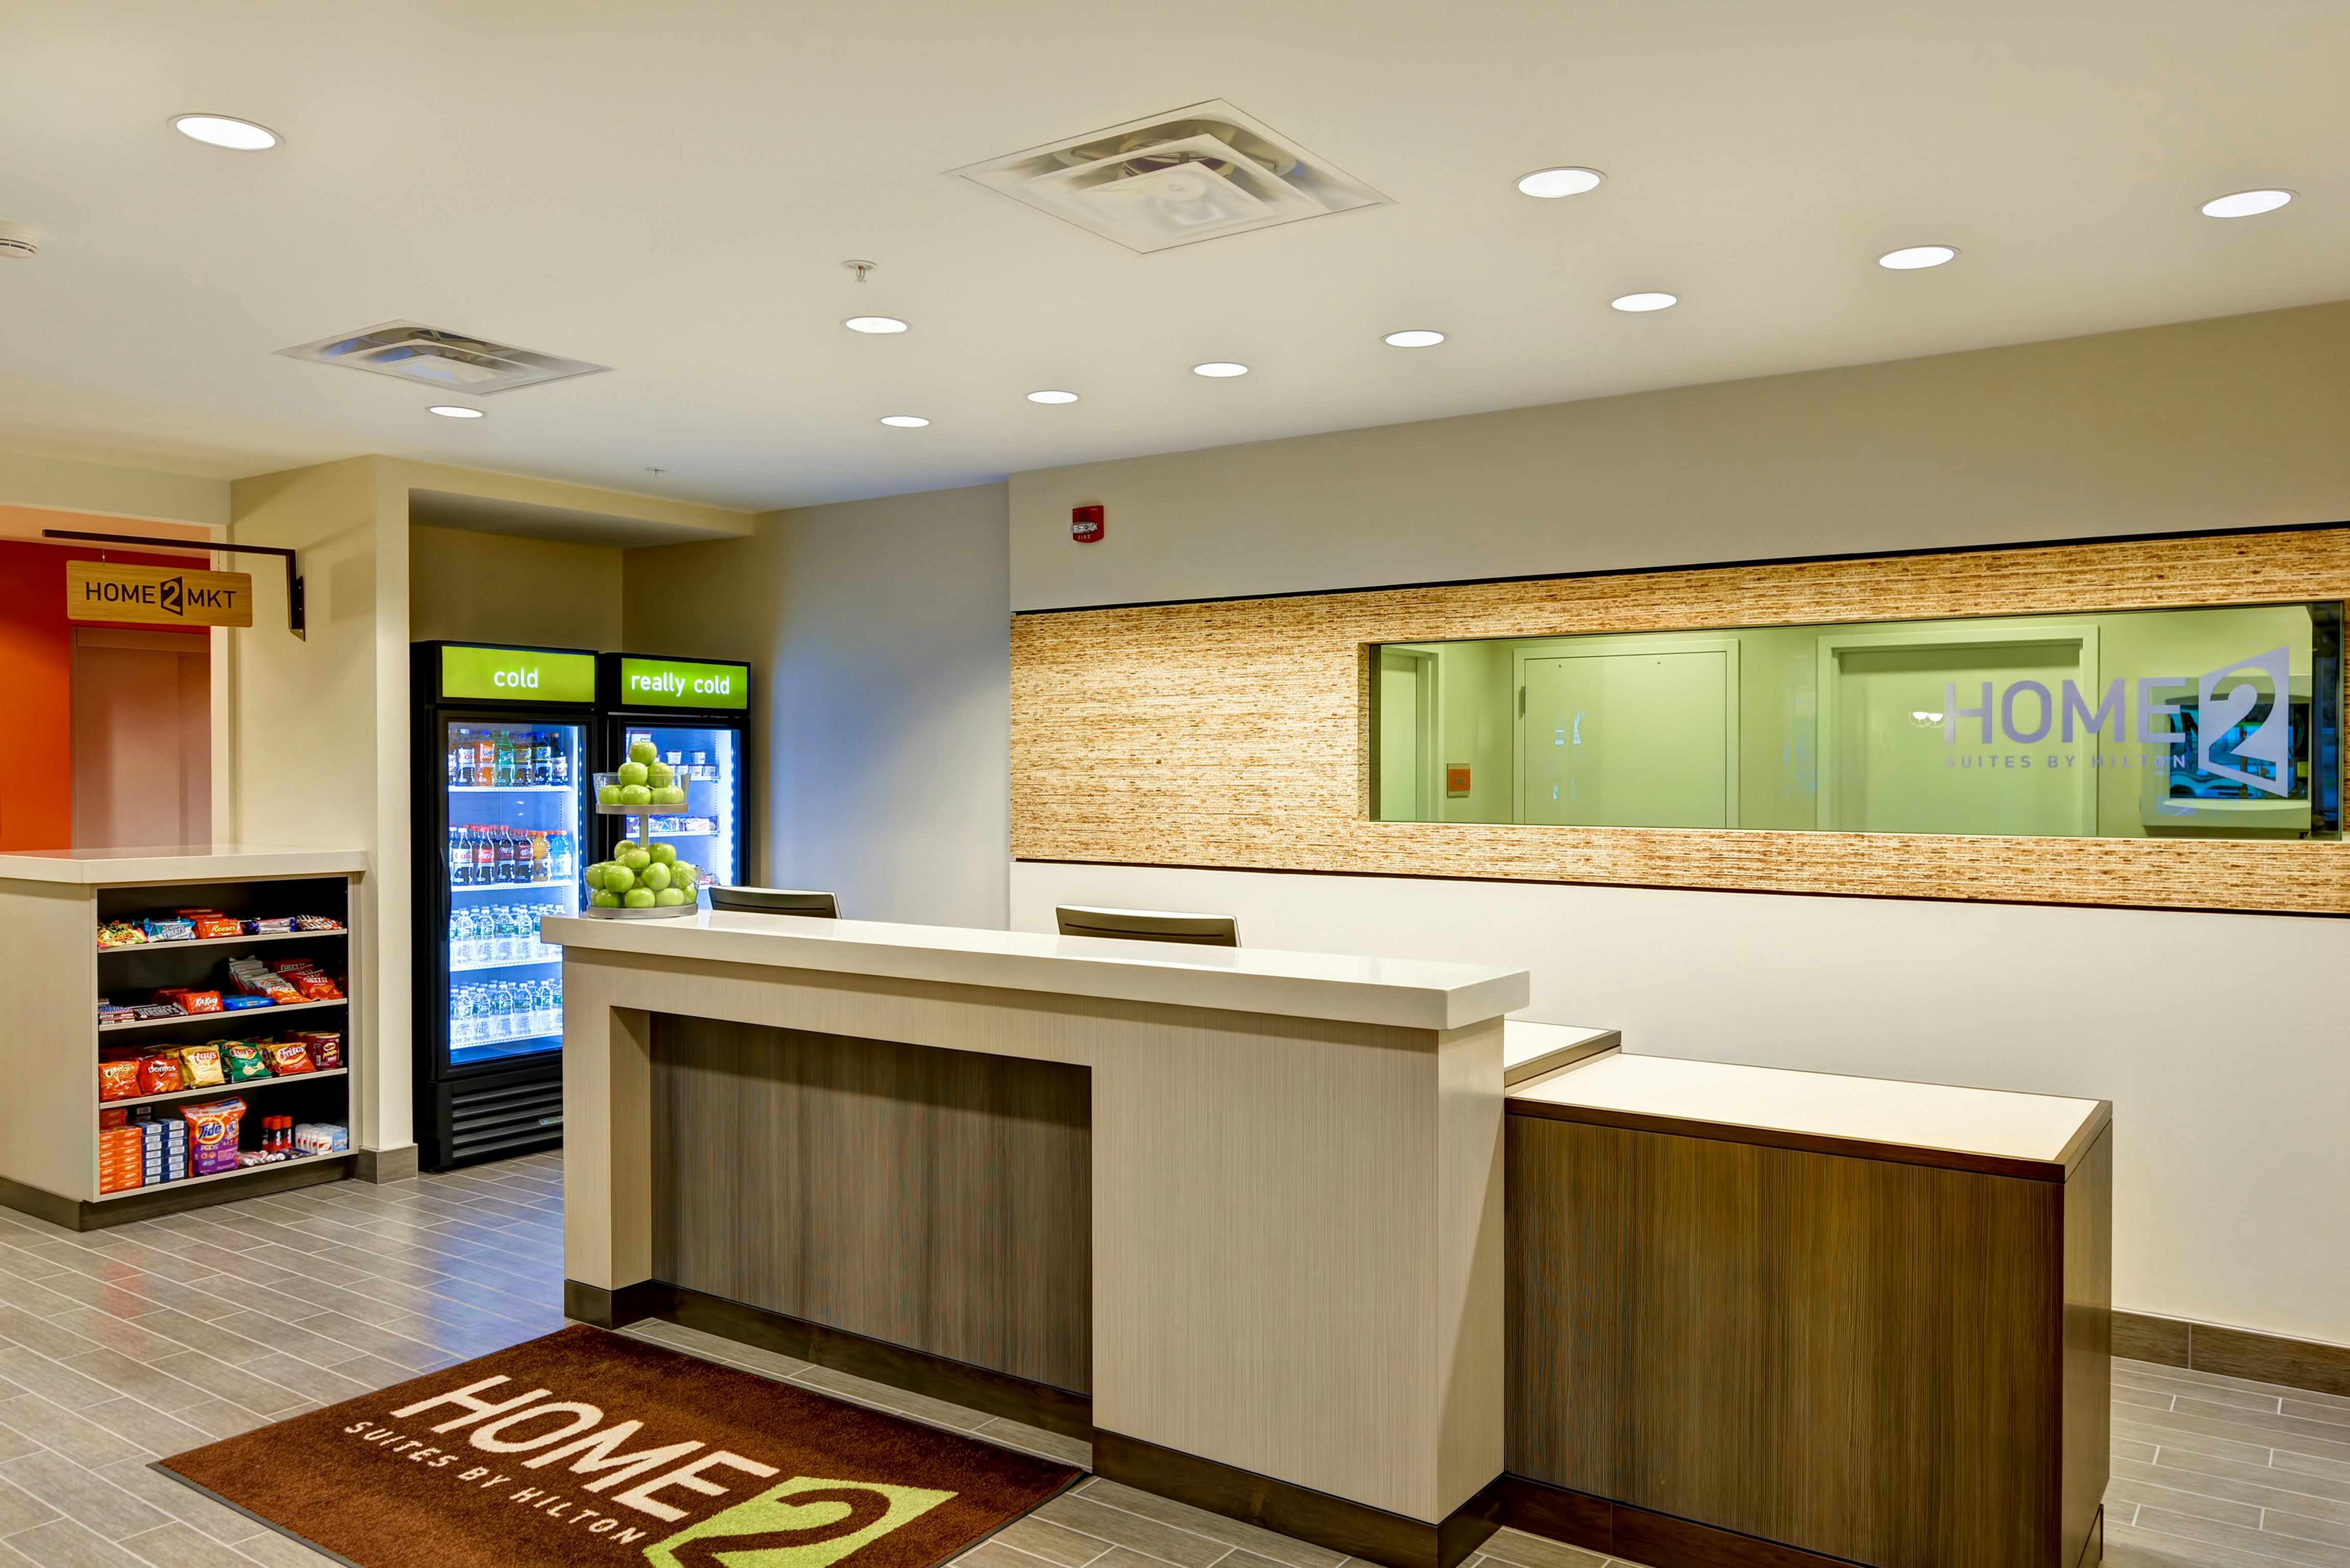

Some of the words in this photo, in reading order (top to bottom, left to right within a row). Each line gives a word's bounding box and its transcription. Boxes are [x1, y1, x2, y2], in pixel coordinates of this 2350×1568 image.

[86, 581, 156, 604] HOME
[162, 580, 181, 613] 2
[187, 588, 237, 609] MKT
[494, 667, 538, 689] cold
[631, 672, 685, 697] really
[694, 675, 730, 695] cold
[1944, 677, 2187, 744] HOME
[2208, 665, 2278, 783] 2
[1944, 755, 2031, 768] SUITES
[2047, 755, 2075, 768] BY
[2092, 754, 2186, 768] HILTON
[111, 933, 135, 942] PATCH
[163, 927, 185, 940] TREATS
[277, 1045, 305, 1061] Fritos
[148, 1065, 176, 1073] Doritos
[198, 1122, 222, 1140] Tide
[389, 1374, 780, 1523] HOME
[344, 1421, 459, 1468] SUITES
[457, 1466, 511, 1488] BY
[509, 1486, 647, 1544] HILTON
